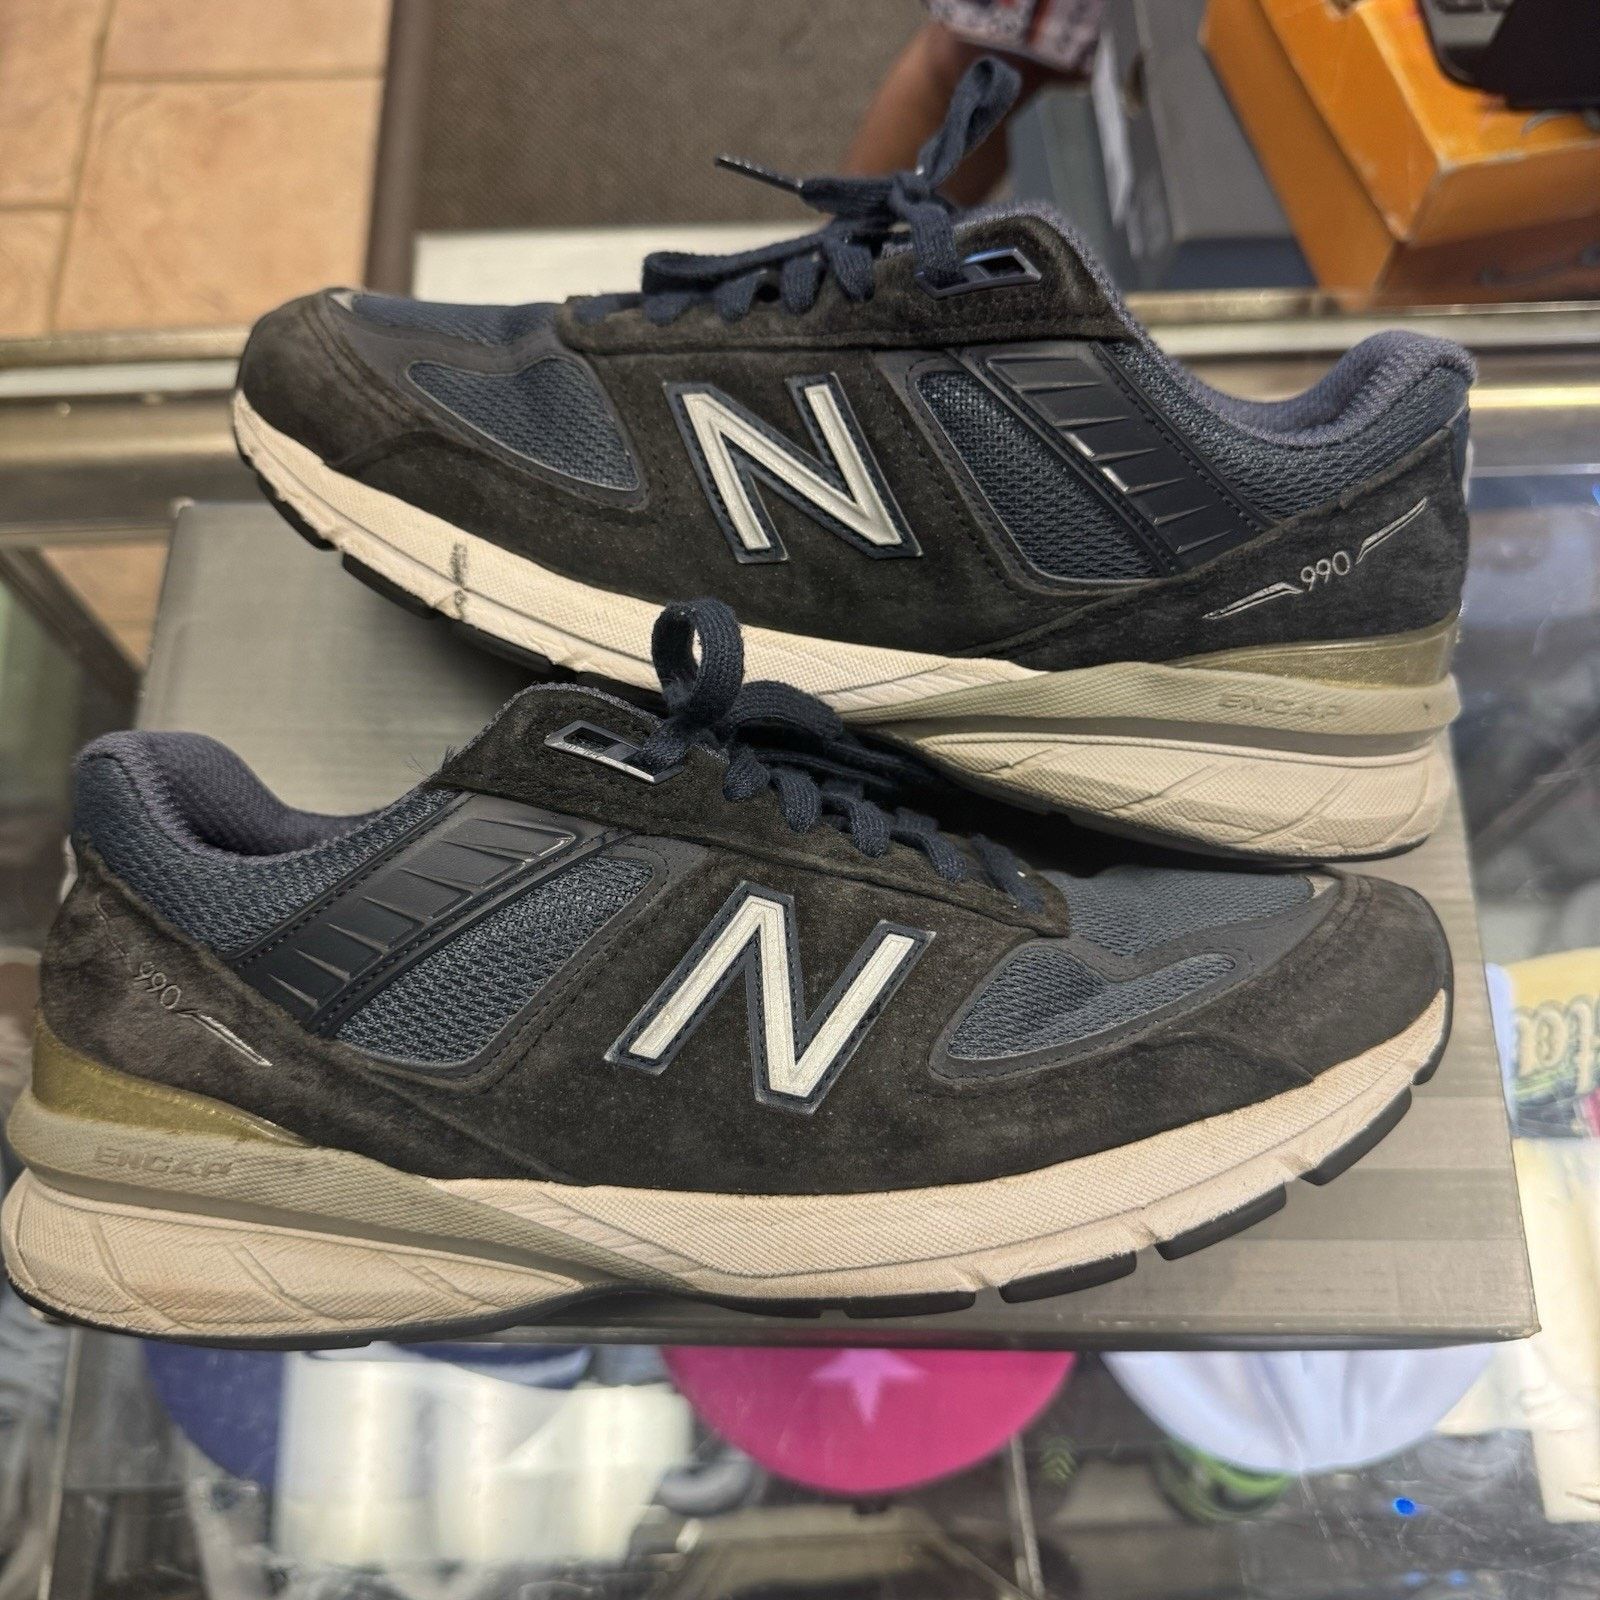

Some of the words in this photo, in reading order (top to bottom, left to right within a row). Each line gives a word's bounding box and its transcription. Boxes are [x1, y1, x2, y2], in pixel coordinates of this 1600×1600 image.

[672, 377, 912, 557] N
[1300, 551, 1350, 592] 990
[134, 961, 182, 1010] 990
[618, 888, 925, 1106] N
[94, 1147, 234, 1179] ENCAP
